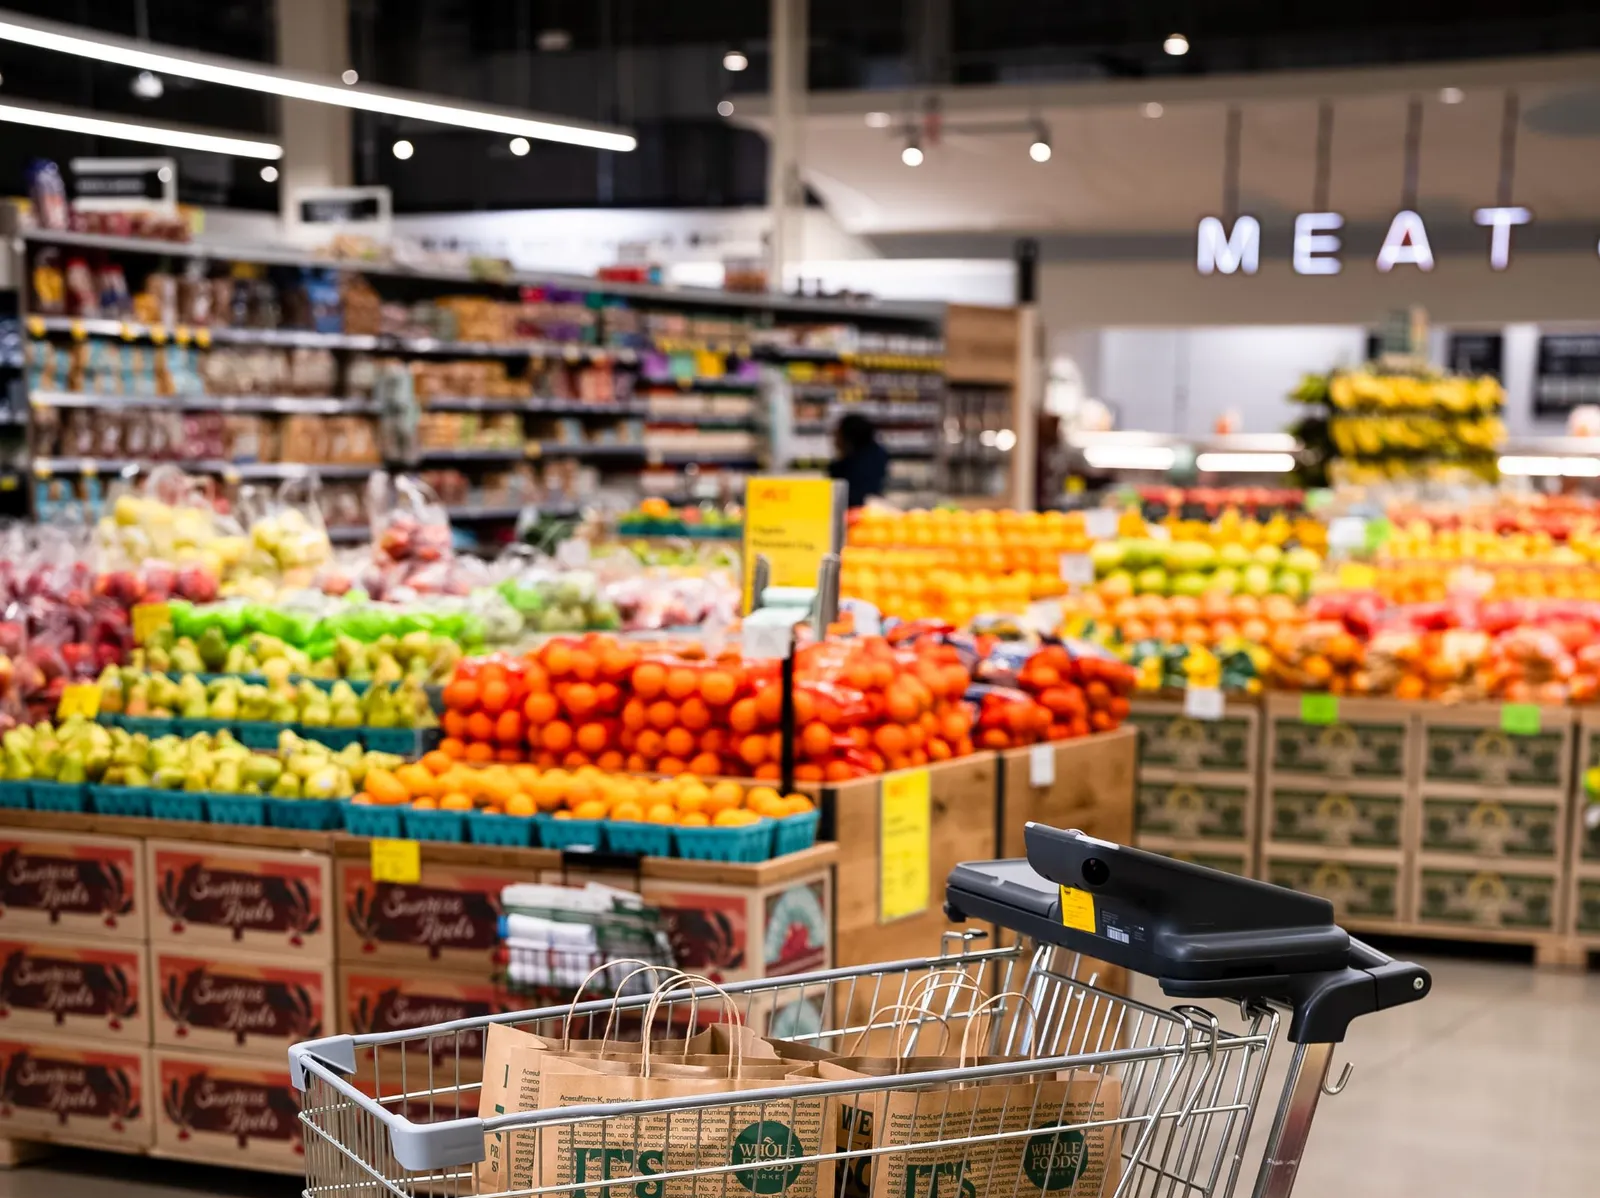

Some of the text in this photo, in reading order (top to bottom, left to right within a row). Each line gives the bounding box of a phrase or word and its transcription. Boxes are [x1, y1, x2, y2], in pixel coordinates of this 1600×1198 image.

[1197, 207, 1532, 275] MEAT
[739, 1143, 796, 1157] WHOLE
[1031, 1142, 1081, 1156] WHOLE
[743, 1158, 794, 1172] FOODS
[1032, 1156, 1080, 1170] FOODS
